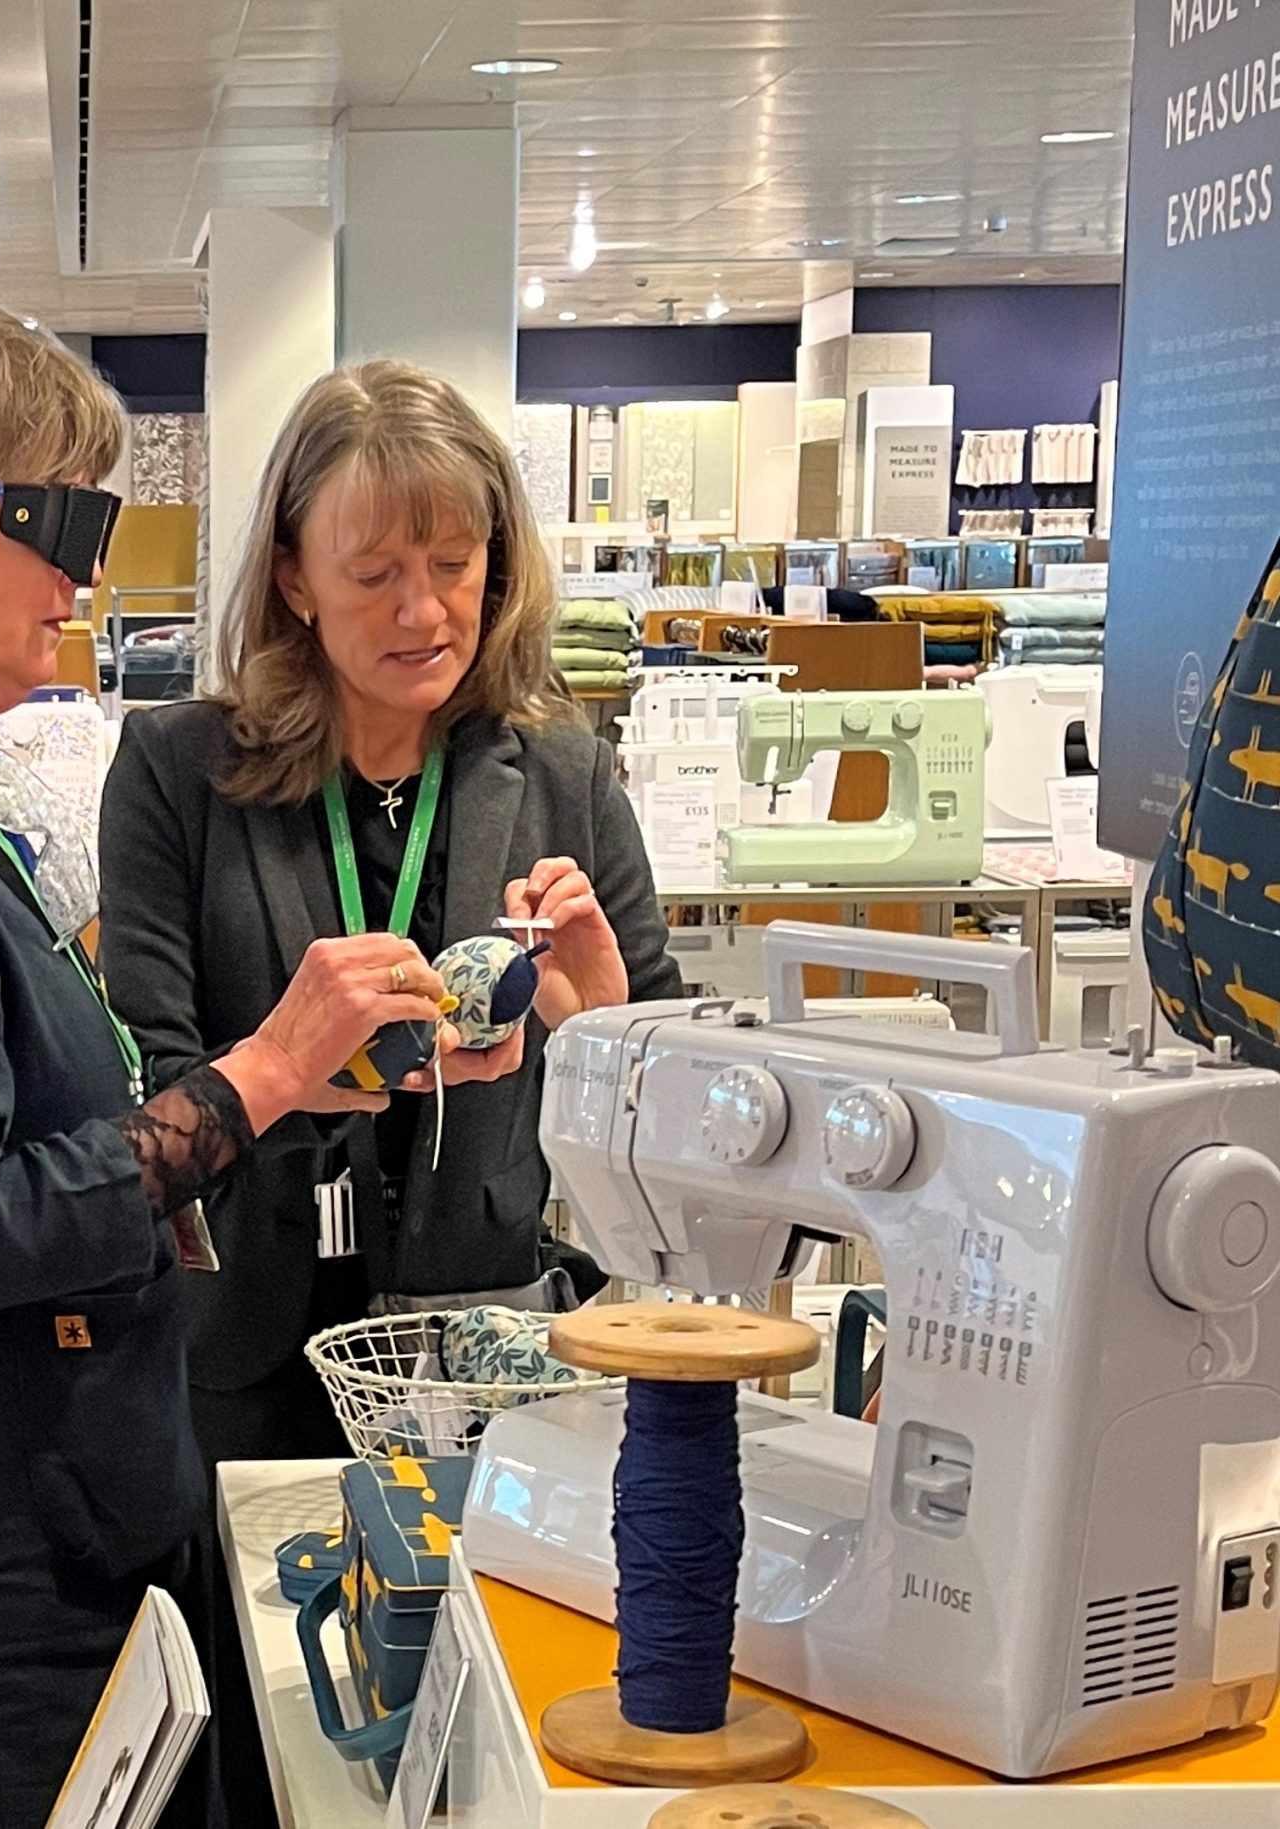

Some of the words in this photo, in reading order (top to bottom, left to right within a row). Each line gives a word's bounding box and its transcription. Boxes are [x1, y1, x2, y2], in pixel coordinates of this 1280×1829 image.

[1165, 51, 1280, 149] MEASURE
[1166, 164, 1273, 247] EXPRESS
[890, 445, 918, 453] MADE
[923, 445, 938, 453] TO
[889, 458, 936, 466] MEASURE
[677, 765, 720, 775] brother
[549, 1056, 577, 1081] John
[901, 1571, 972, 1613] JL110SE
